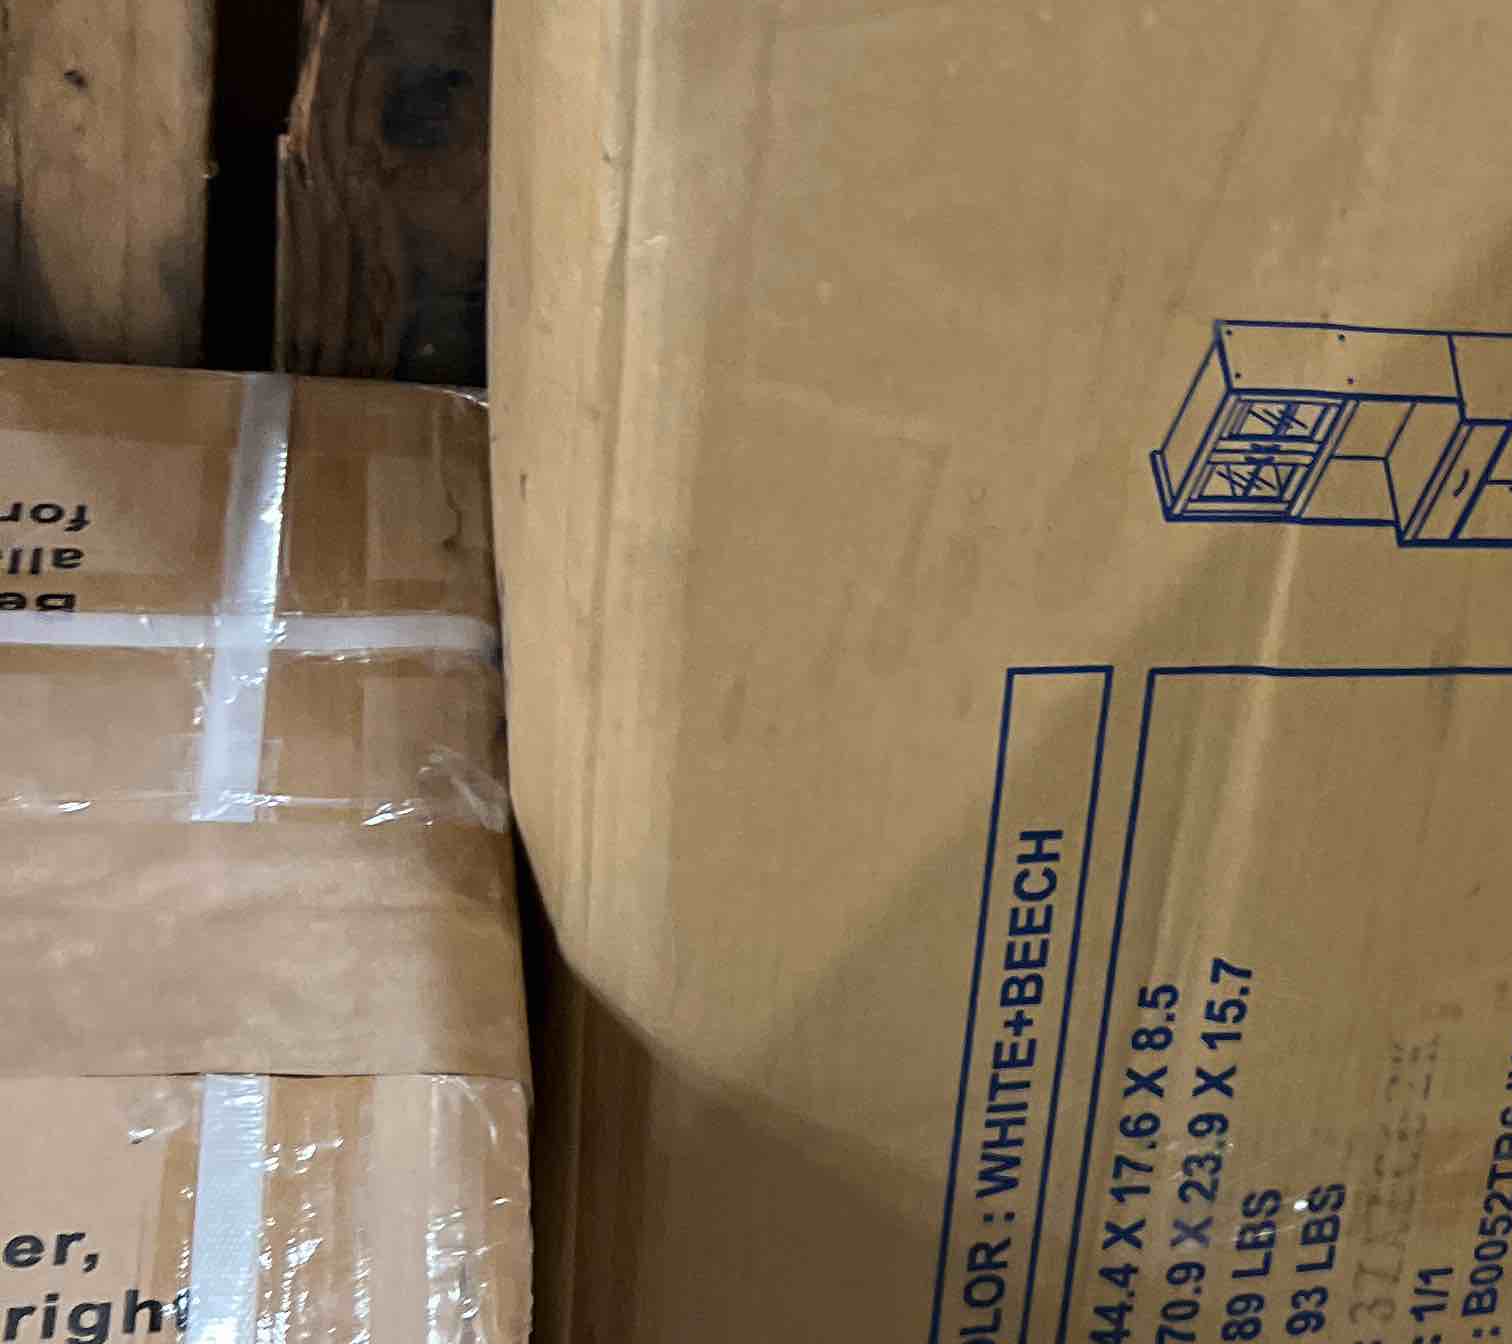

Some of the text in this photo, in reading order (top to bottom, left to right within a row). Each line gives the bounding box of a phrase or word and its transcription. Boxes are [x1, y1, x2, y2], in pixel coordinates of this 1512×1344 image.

[975, 829, 1065, 1199] WHITE+BEECH
[1130, 983, 1180, 1052] 8.5
[1199, 957, 1253, 1051] 15.7
[1121, 1065, 1169, 1099] X
[1191, 1064, 1238, 1099] X
[1108, 1111, 1161, 1204] 17.6
[1177, 1112, 1230, 1204] 23.9
[1101, 1217, 1147, 1251] X
[1169, 1216, 1213, 1248] X
[1230, 1189, 1283, 1281] LBS
[1295, 1183, 1346, 1274] LBS
[1220, 1292, 1266, 1342] 89
[1284, 1285, 1330, 1337] 93
[1408, 1266, 1455, 1324] 1/1
